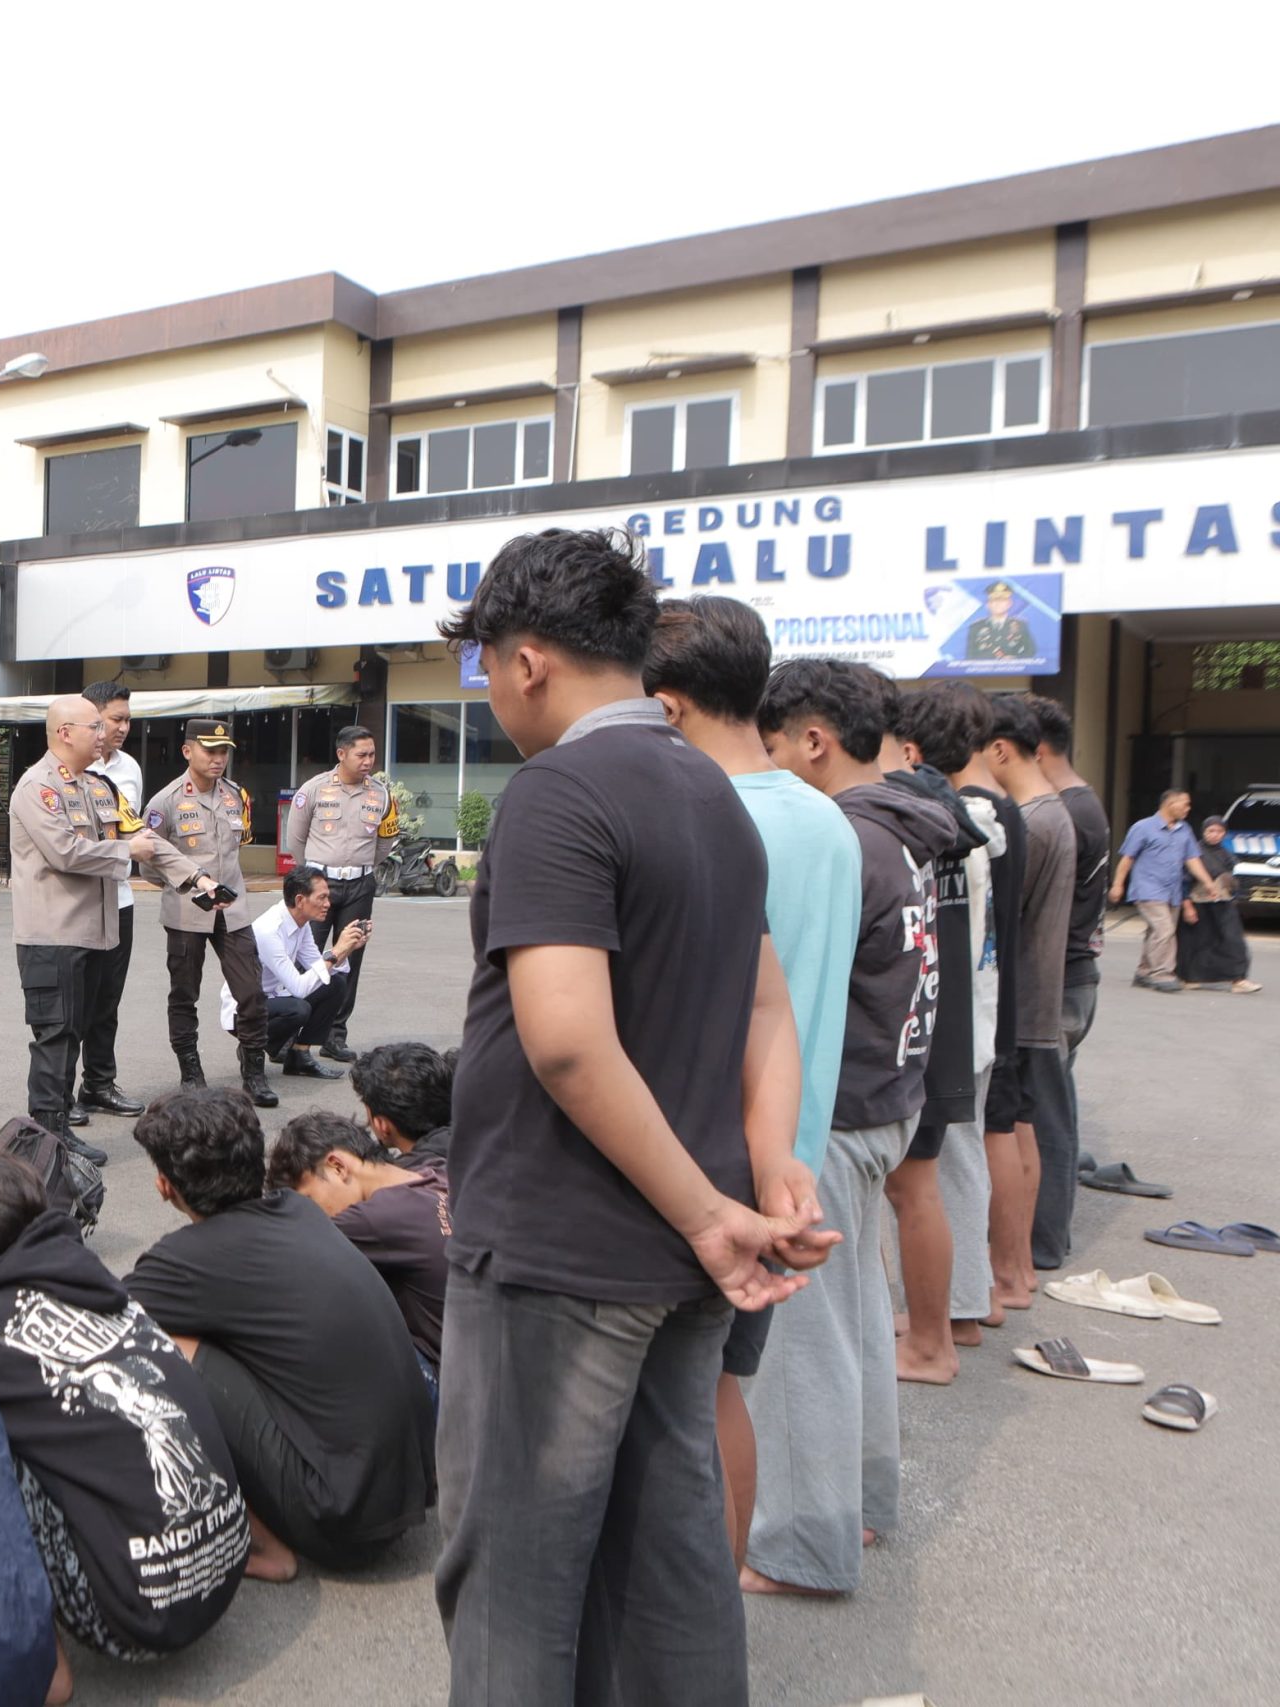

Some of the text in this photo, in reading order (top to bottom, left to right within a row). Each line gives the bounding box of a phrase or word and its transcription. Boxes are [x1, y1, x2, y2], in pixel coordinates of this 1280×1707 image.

[627, 496, 844, 537] GEDUNG
[647, 533, 851, 588] LALU
[925, 503, 1280, 573] LINTA
[774, 611, 929, 646] PROFESIONAL
[179, 812, 199, 820] JODI
[128, 1518, 204, 1560] BANDIT
